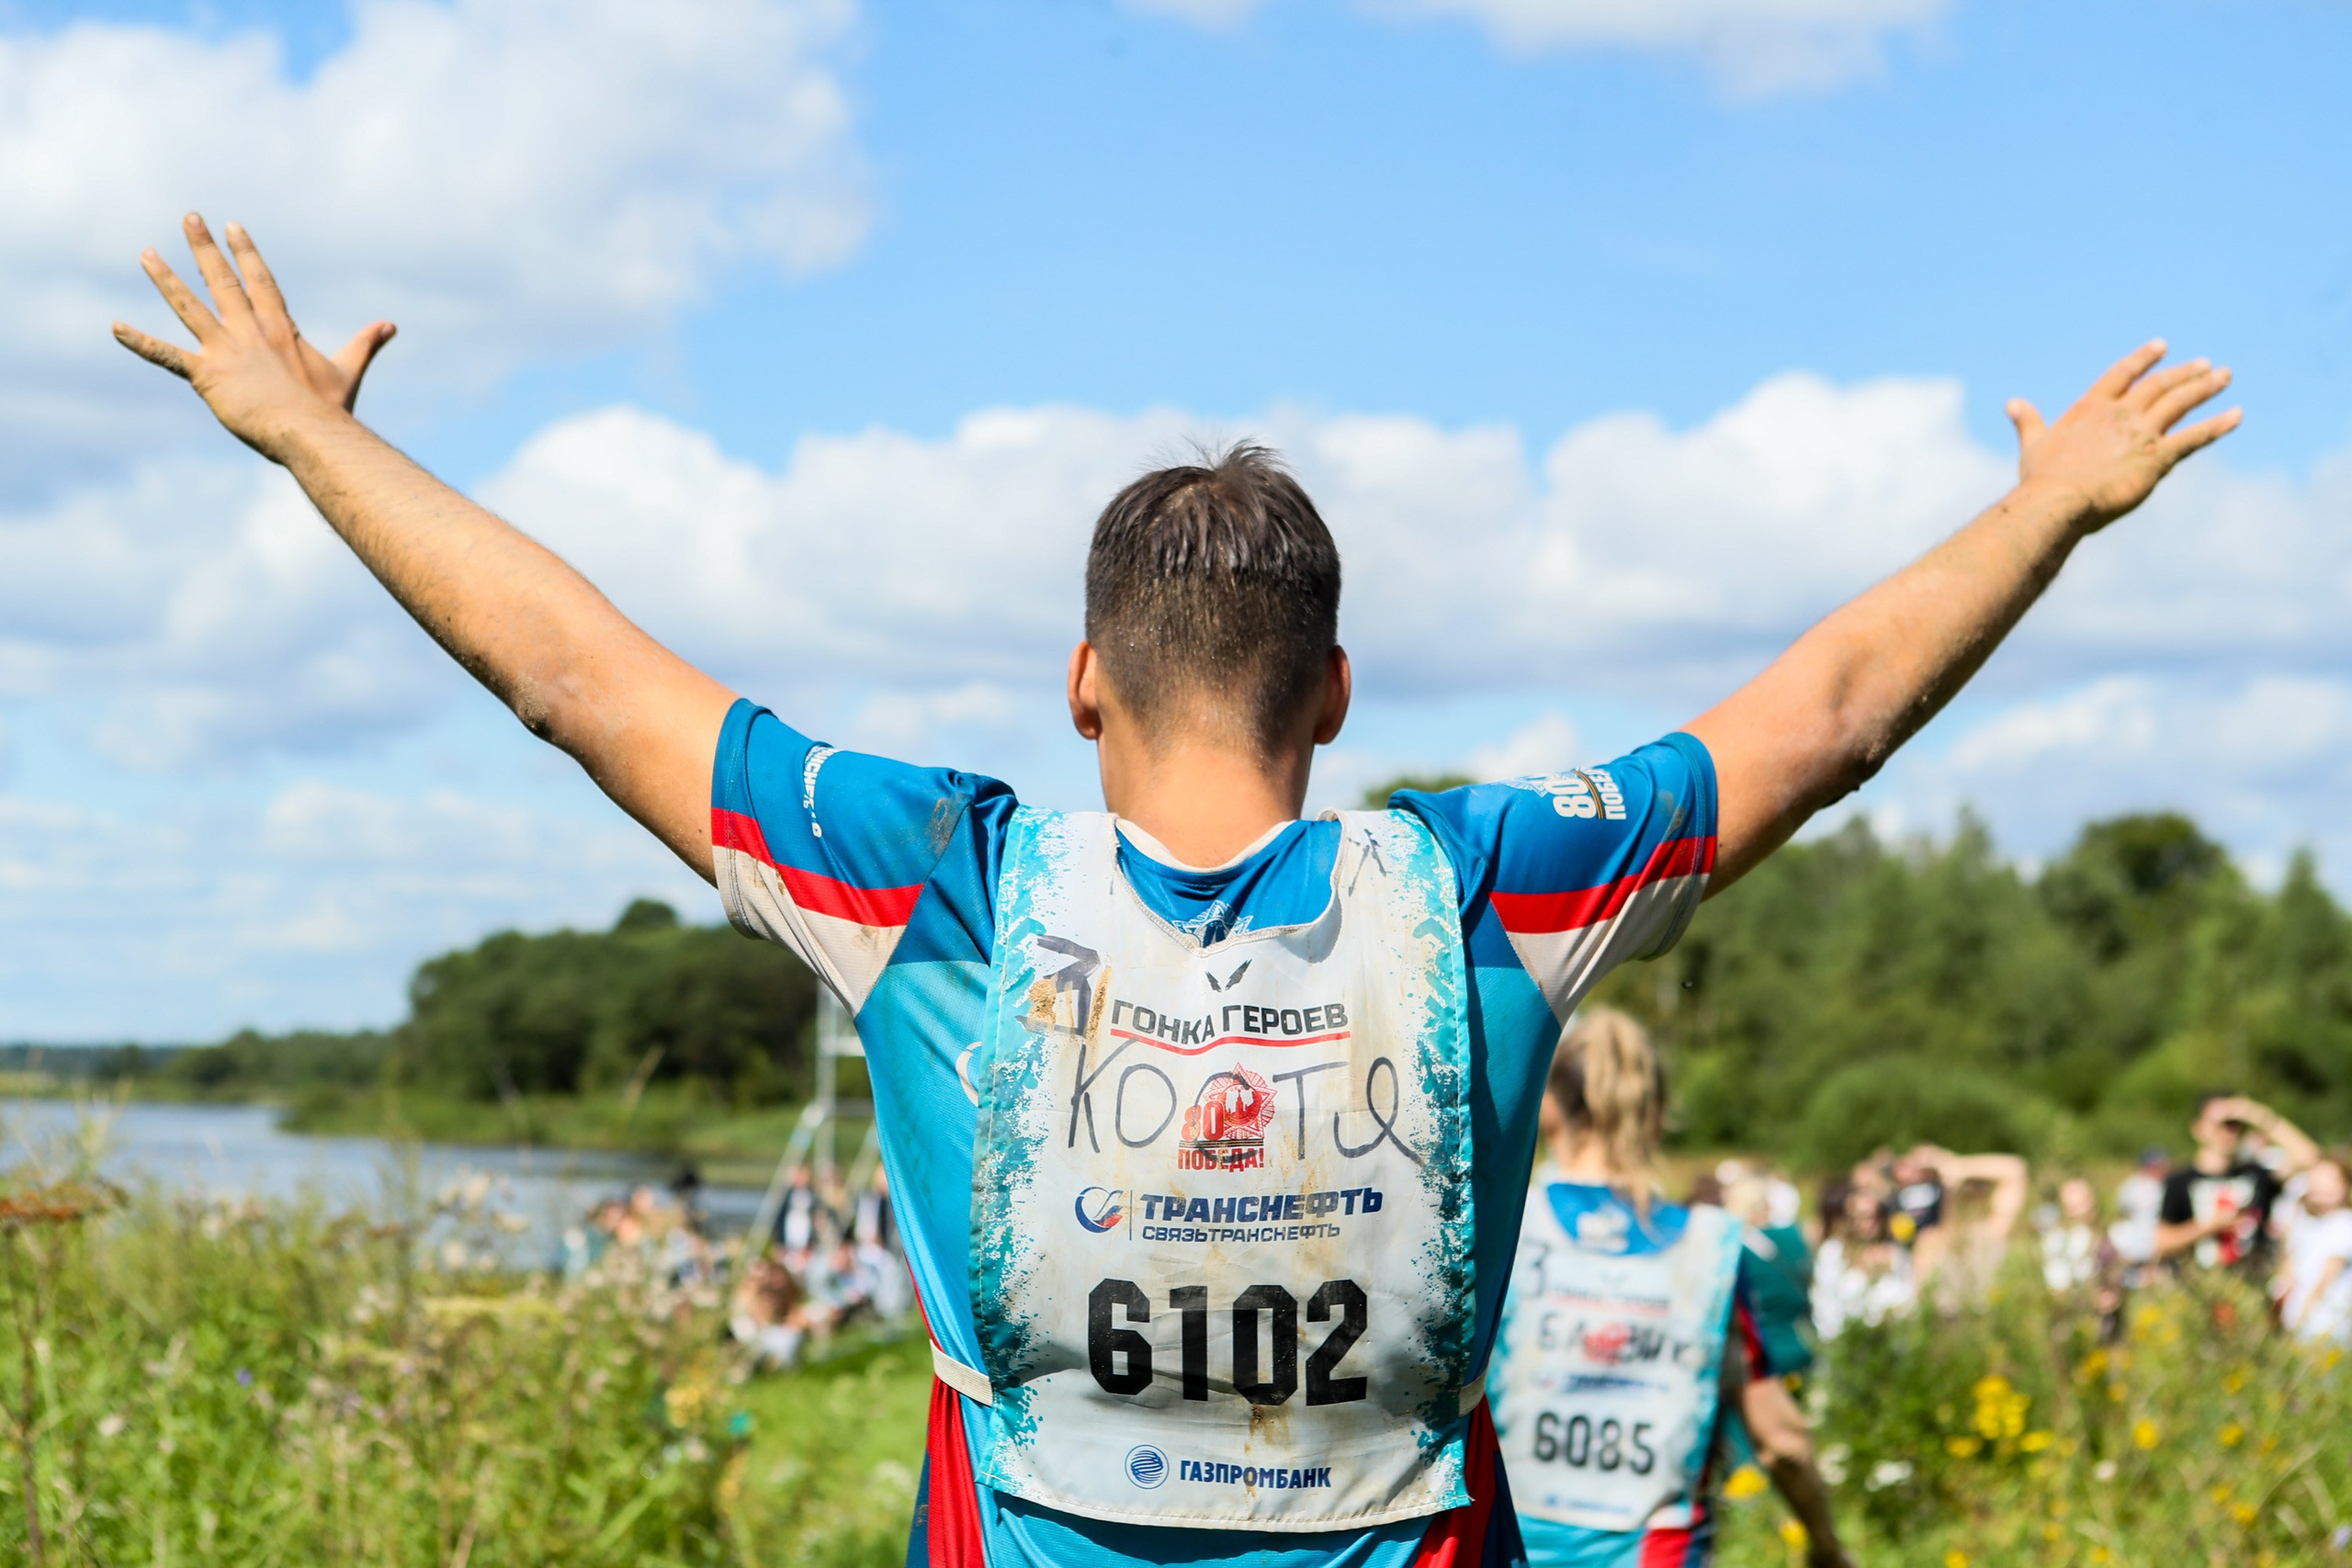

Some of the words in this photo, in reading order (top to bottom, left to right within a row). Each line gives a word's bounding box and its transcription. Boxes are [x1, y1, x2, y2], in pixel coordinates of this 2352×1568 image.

[1543, 777, 1598, 819] 80
[1110, 998, 1216, 1045] ГОНКА
[1222, 1002, 1350, 1036] ГЕРОЕВ
[1068, 1035, 1424, 1166] КОСТЯ
[1180, 1100, 1226, 1143] 80
[1177, 1147, 1265, 1173] ПОБЕДА!
[1139, 1187, 1384, 1224] ТРАНСНЕФТЬ
[1141, 1223, 1341, 1244] СВЯЗЬТРАНСНЕФТЬ
[1088, 1278, 1368, 1406] 6102
[1532, 1410, 1657, 1475] 6085
[1180, 1460, 1332, 1489] ГАЗПРОМБАНК
